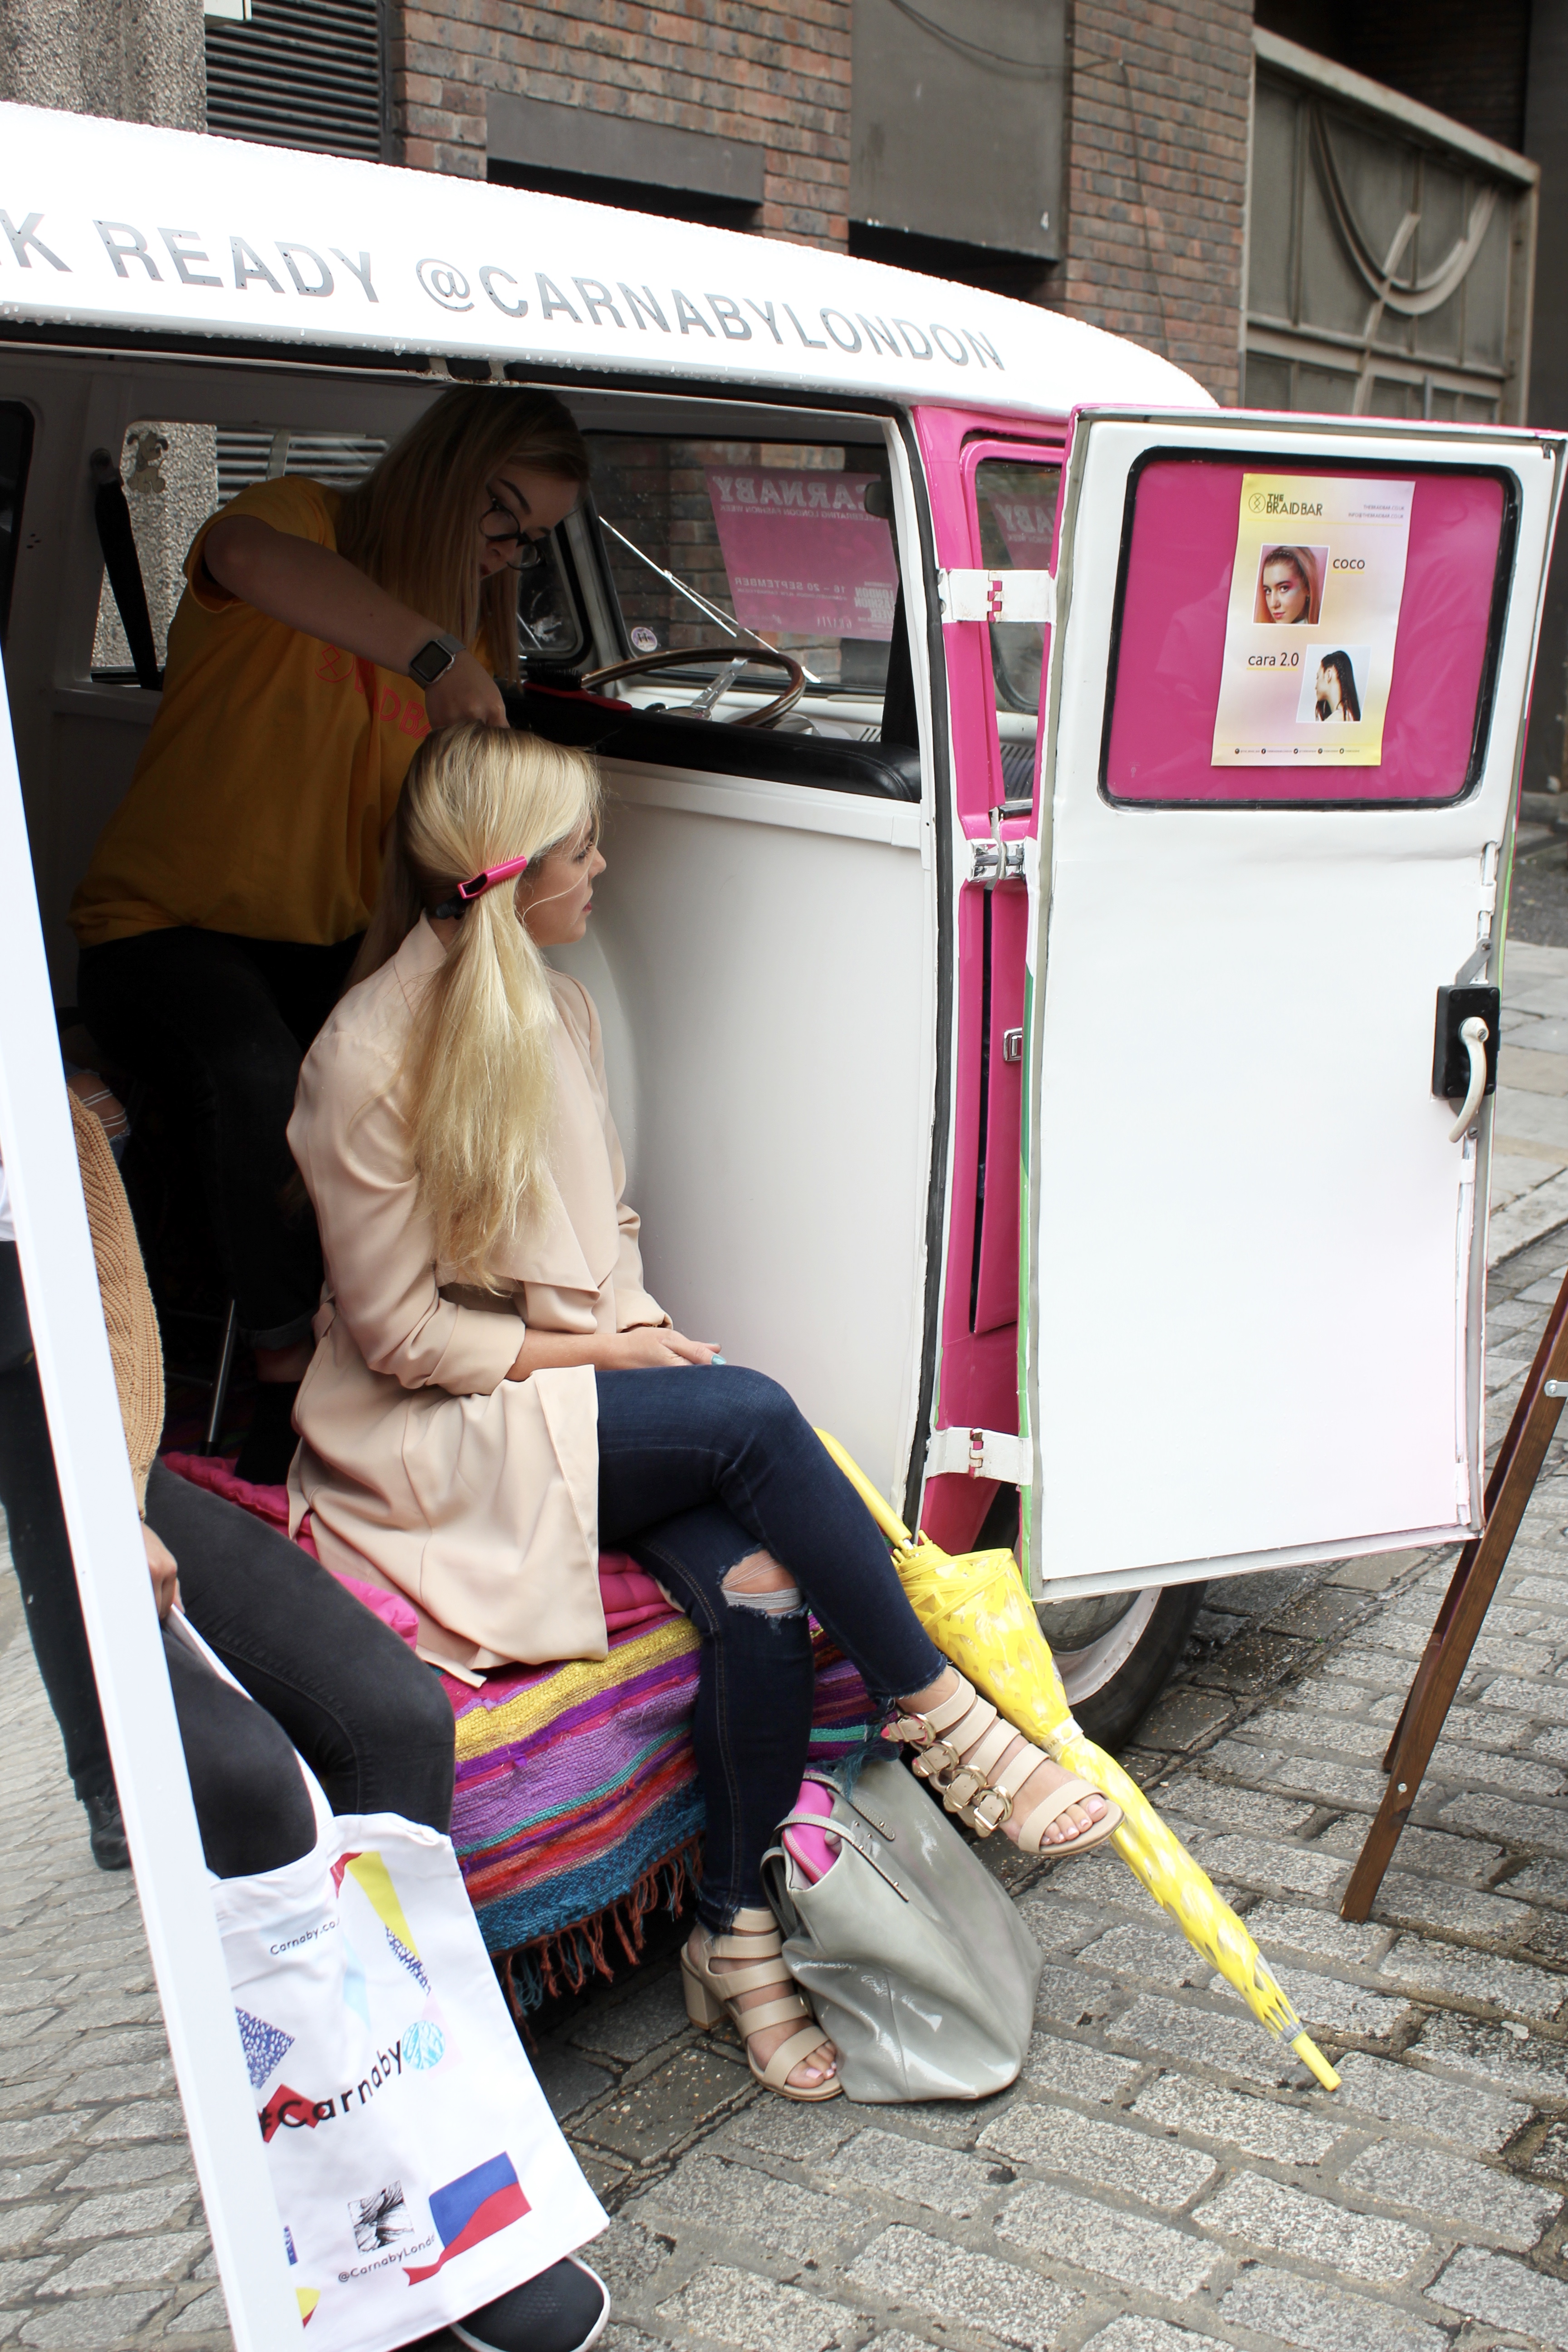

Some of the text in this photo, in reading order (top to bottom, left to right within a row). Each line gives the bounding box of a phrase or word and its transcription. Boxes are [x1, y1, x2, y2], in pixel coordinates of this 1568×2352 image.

[92, 220, 379, 303] READY
[416, 257, 1005, 371] @CARNABYLONDON
[1267, 494, 1284, 502] THE
[1248, 652, 1299, 666] cara 2.0
[270, 1916, 340, 1955] Carnaby.co
